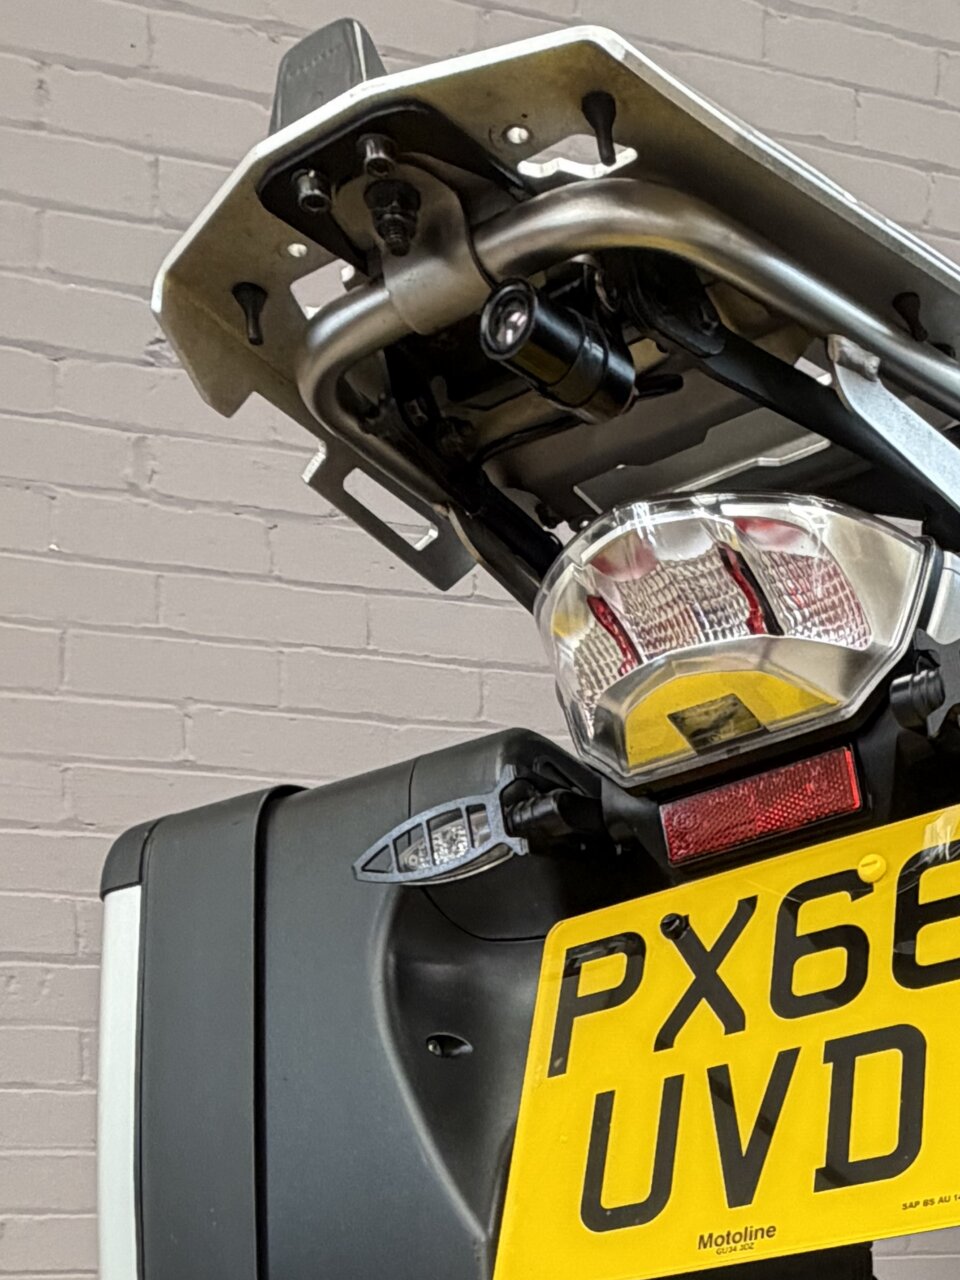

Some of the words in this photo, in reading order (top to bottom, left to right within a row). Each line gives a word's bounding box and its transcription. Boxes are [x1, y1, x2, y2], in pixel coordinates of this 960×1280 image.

[579, 1023, 927, 1233] UVD
[937, 1195, 951, 1204] AU
[697, 1225, 777, 1250] Motoline
